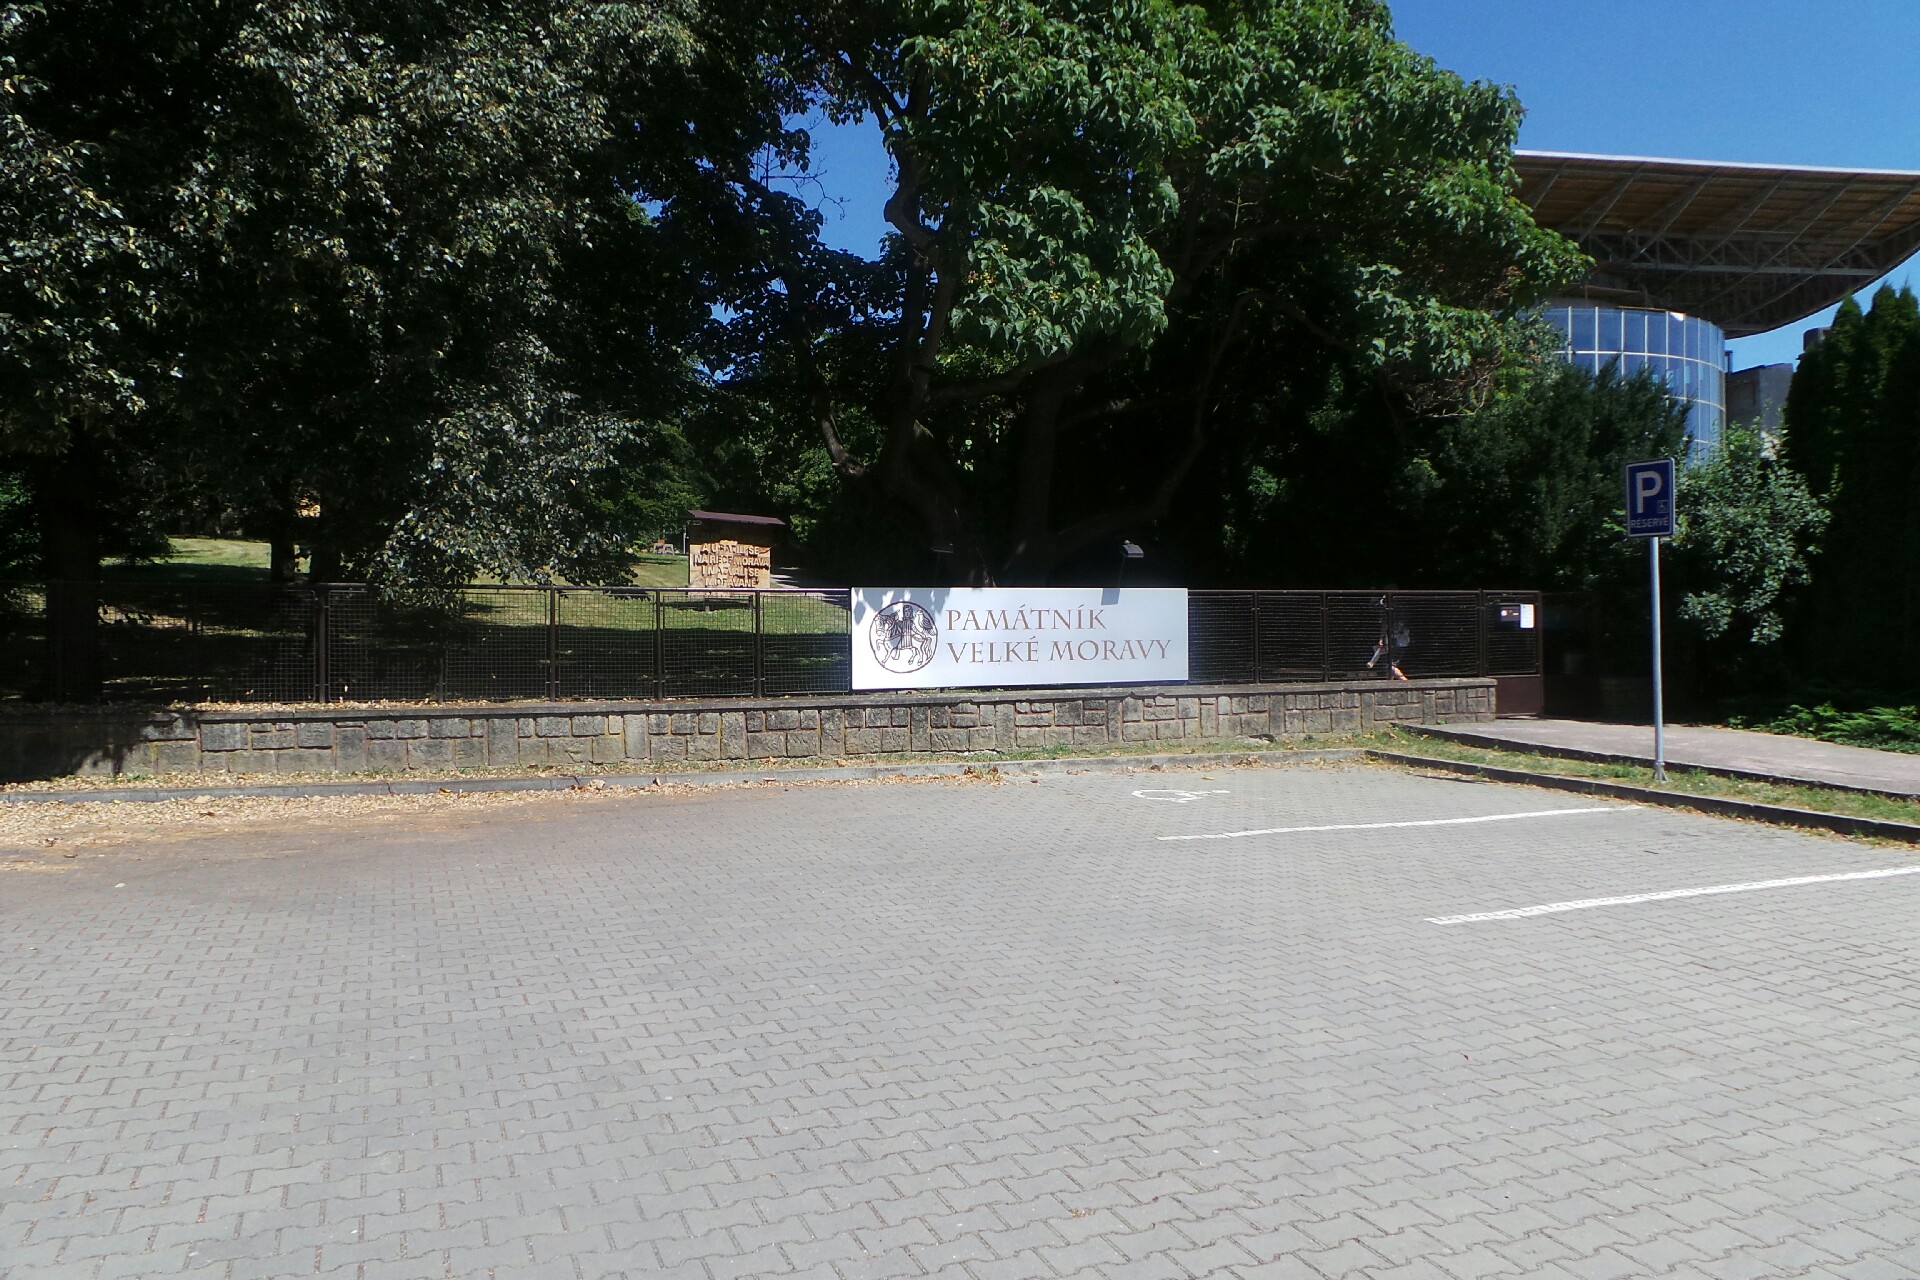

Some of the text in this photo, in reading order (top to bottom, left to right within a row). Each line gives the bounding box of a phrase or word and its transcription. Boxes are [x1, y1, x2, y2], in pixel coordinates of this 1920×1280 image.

[1635, 470, 1662, 514] P
[945, 603, 1107, 631] PAMÁTNÍK
[946, 635, 1172, 664] VELKÉ MORAVY
